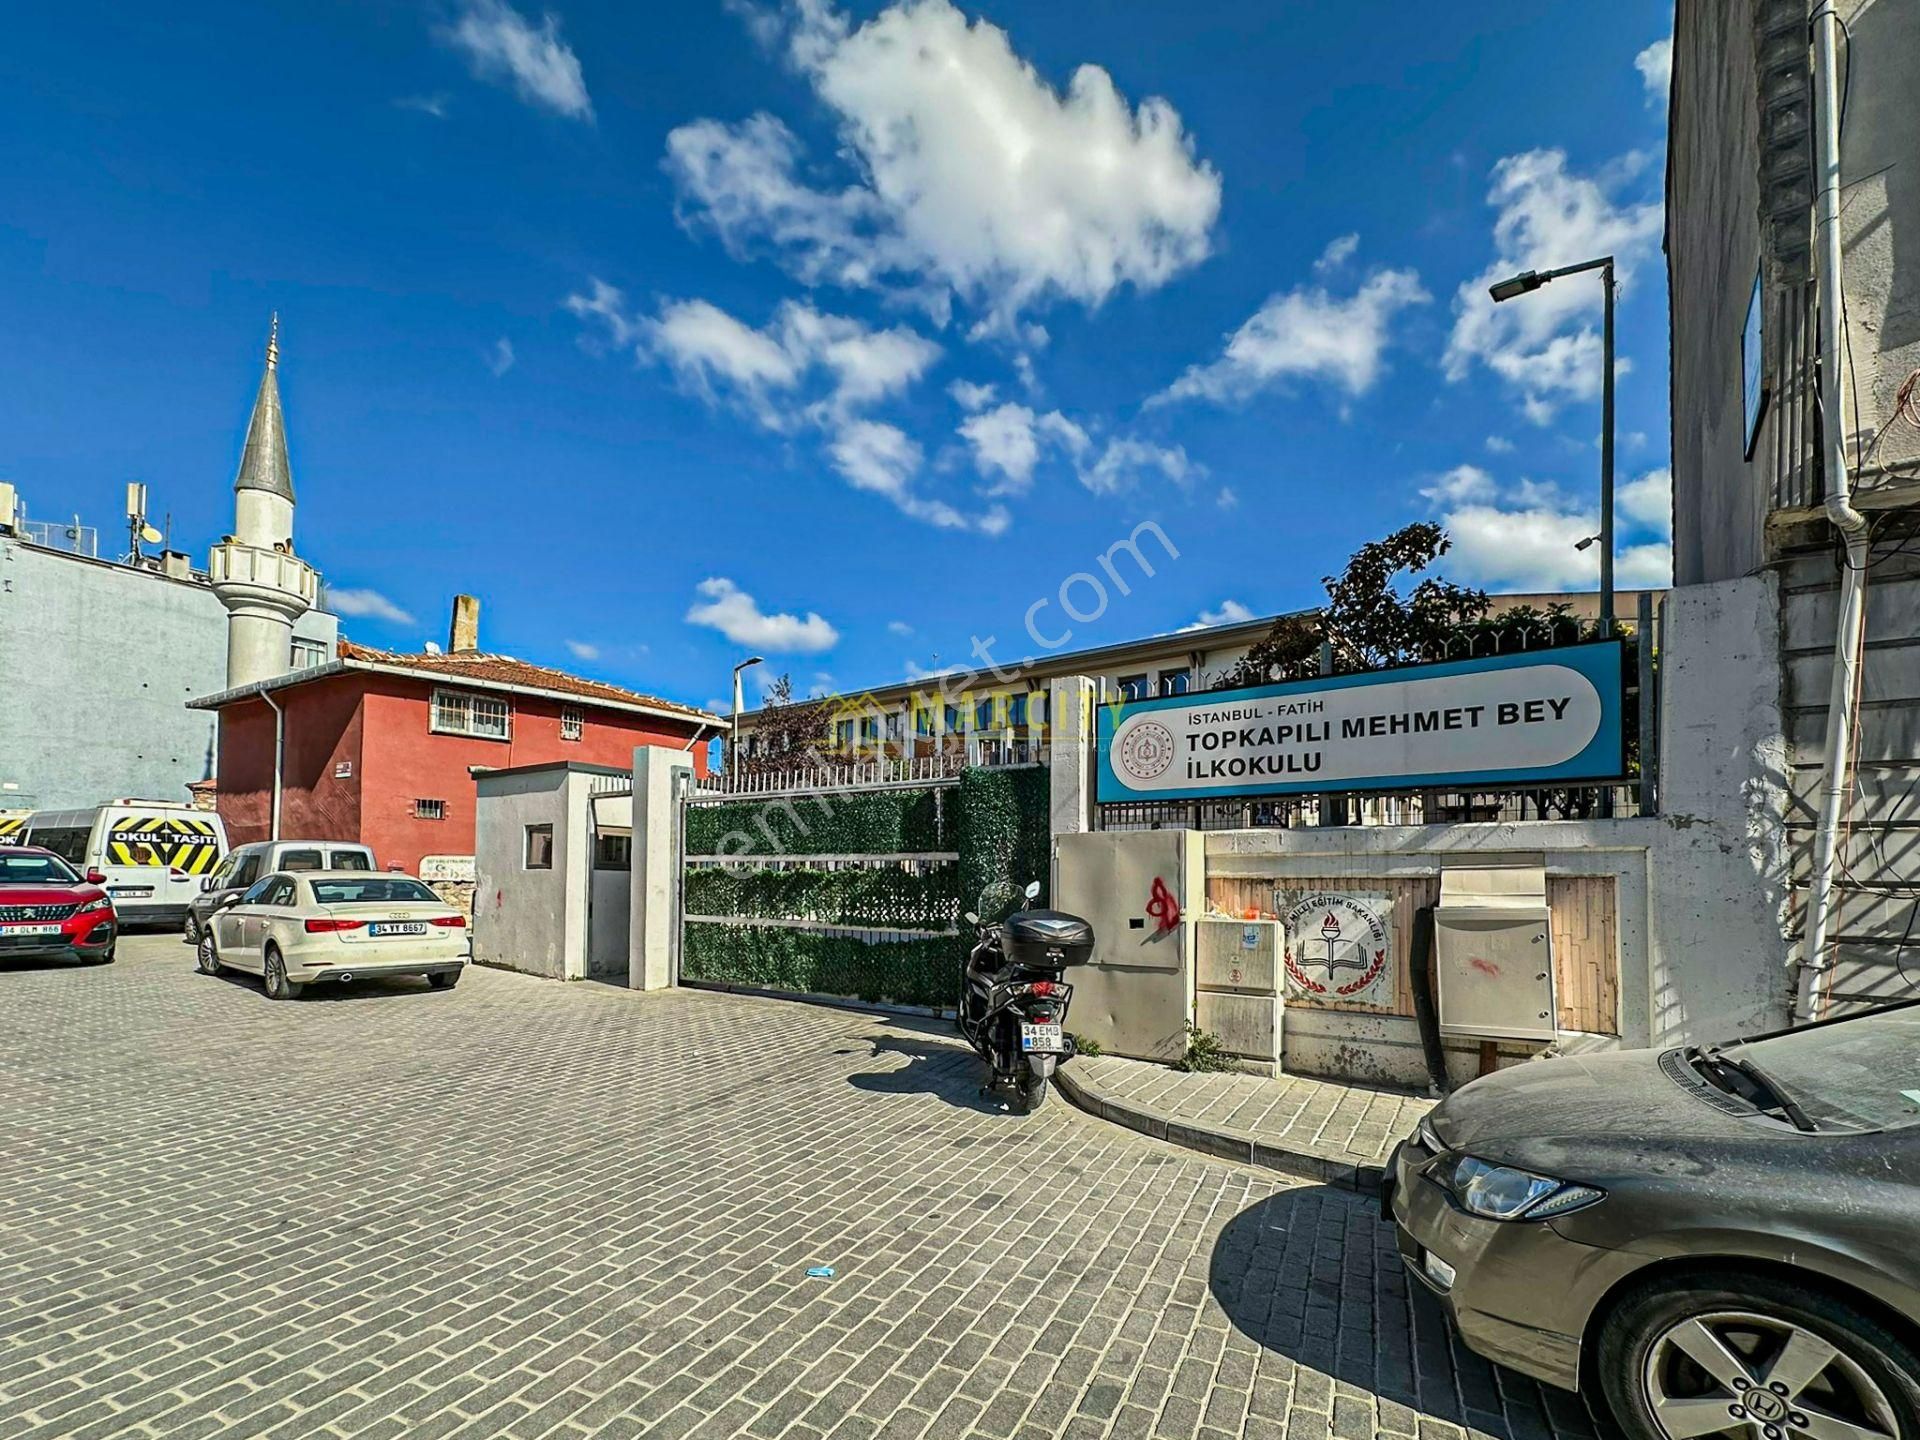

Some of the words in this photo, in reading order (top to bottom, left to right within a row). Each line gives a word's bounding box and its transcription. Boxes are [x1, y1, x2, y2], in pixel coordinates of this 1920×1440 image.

[1187, 707, 1263, 726] İSTANBUL
[1277, 699, 1324, 716] FATİH
[1186, 721, 1330, 752] TOPKAPILI
[1342, 705, 1485, 739] MEHMET
[1497, 697, 1572, 726] BEY
[1186, 752, 1322, 779] İLKOKULU
[115, 832, 162, 843] OKUL
[1311, 896, 1344, 908] EĞİTİM
[1345, 901, 1384, 942] BAKANLIĞI
[4, 926, 15, 934] 34
[375, 924, 387, 934] 34
[1024, 1026, 1036, 1036] 34
[1032, 1037, 1051, 1047] 858
